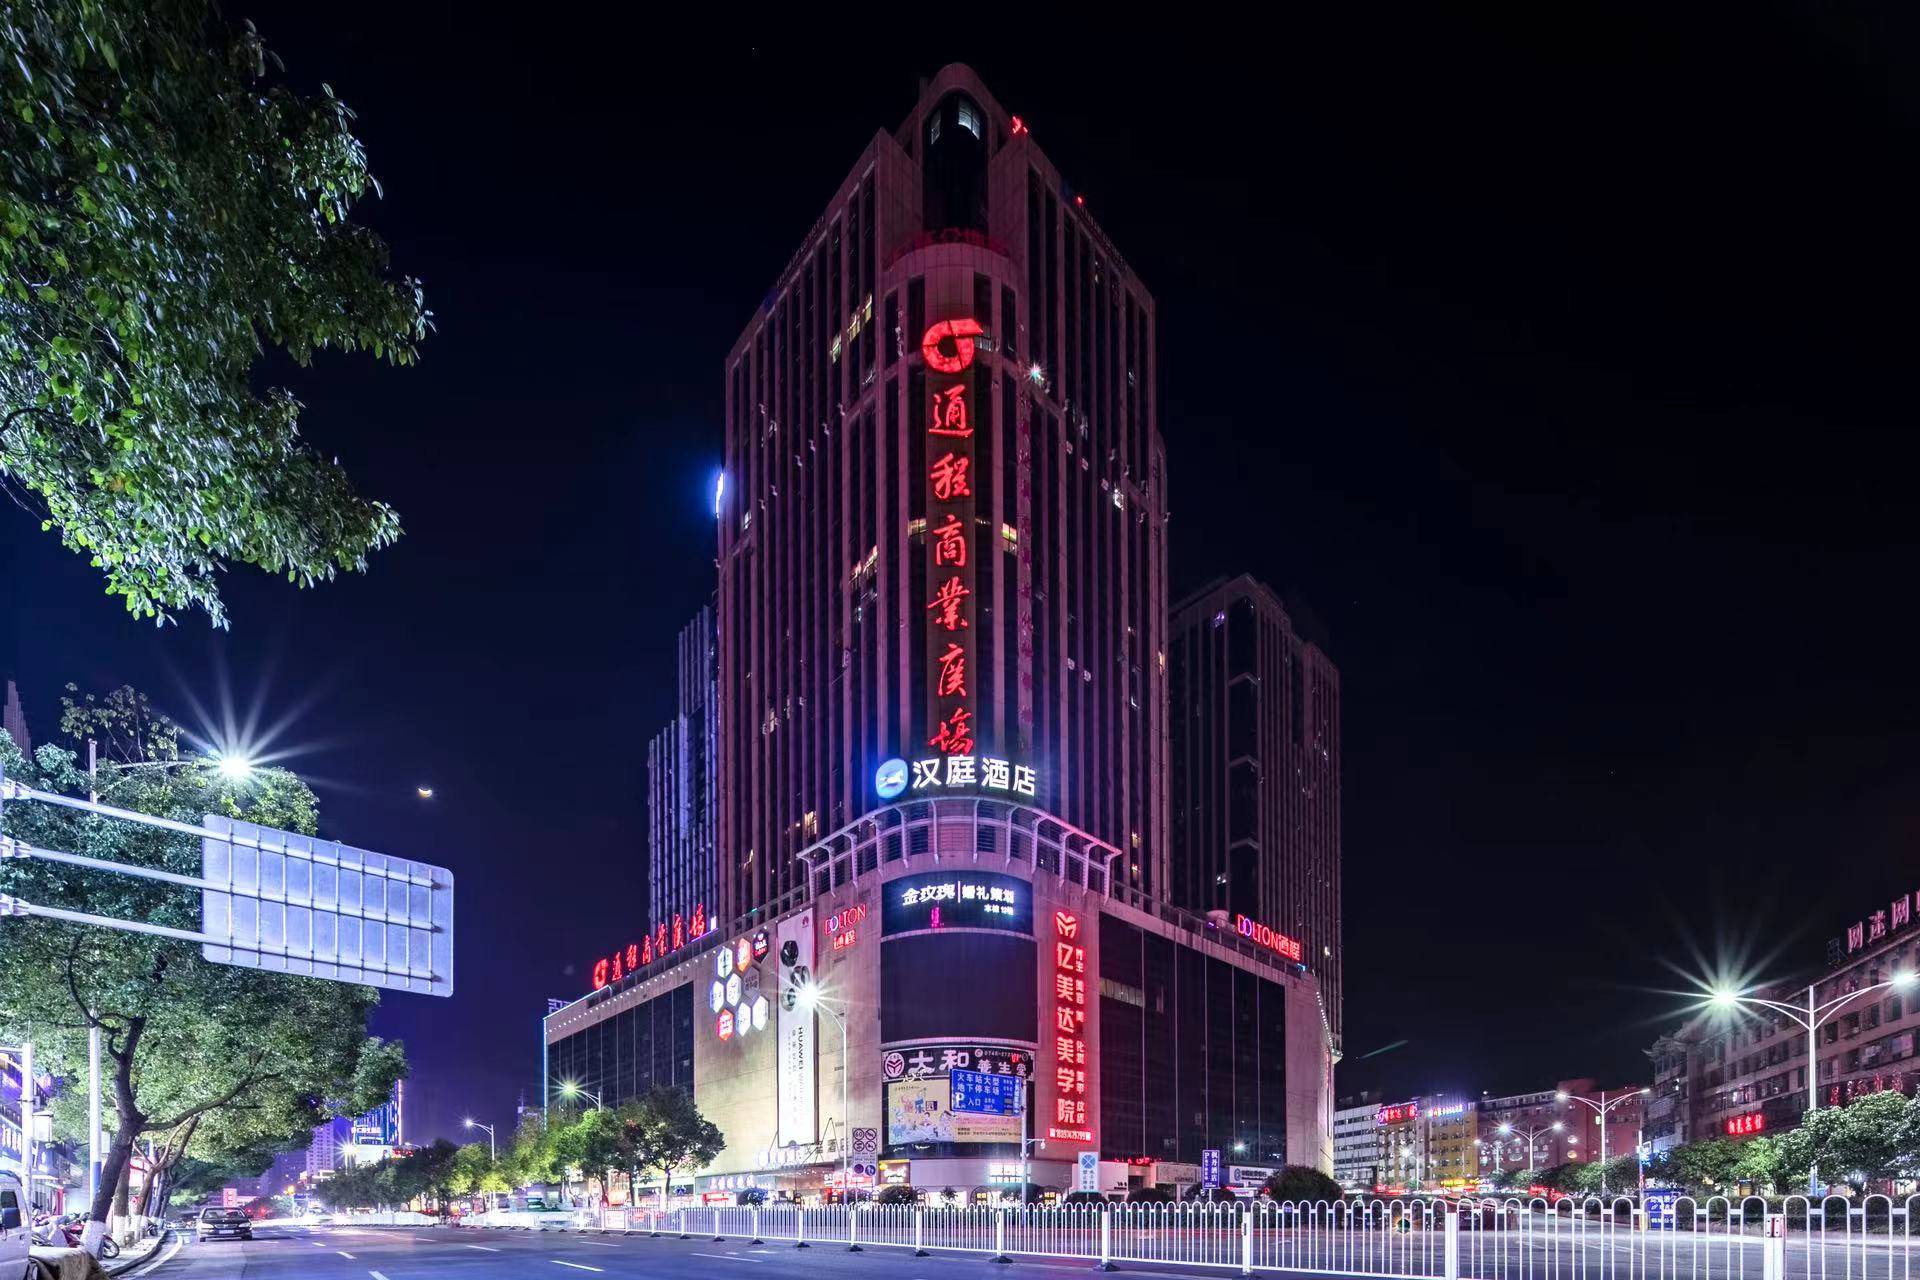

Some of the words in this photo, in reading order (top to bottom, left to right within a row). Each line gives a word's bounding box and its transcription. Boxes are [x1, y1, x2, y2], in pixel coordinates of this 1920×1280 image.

[912, 754, 1036, 797] 汉庭酒店
[902, 883, 956, 906] 金玫瑰
[961, 884, 1015, 904] 婚礼策划
[825, 904, 866, 936] DOLTON
[1237, 914, 1279, 950] DOLTON
[1847, 889, 1920, 953] 网迷网
[833, 930, 856, 950] 通程
[1056, 942, 1075, 1124] 亿美达美学院
[908, 1050, 970, 1076] 大和
[957, 1073, 1000, 1087] 火车站大型
[957, 1083, 1000, 1096] 地下停车场
[968, 1098, 981, 1106] 入口
